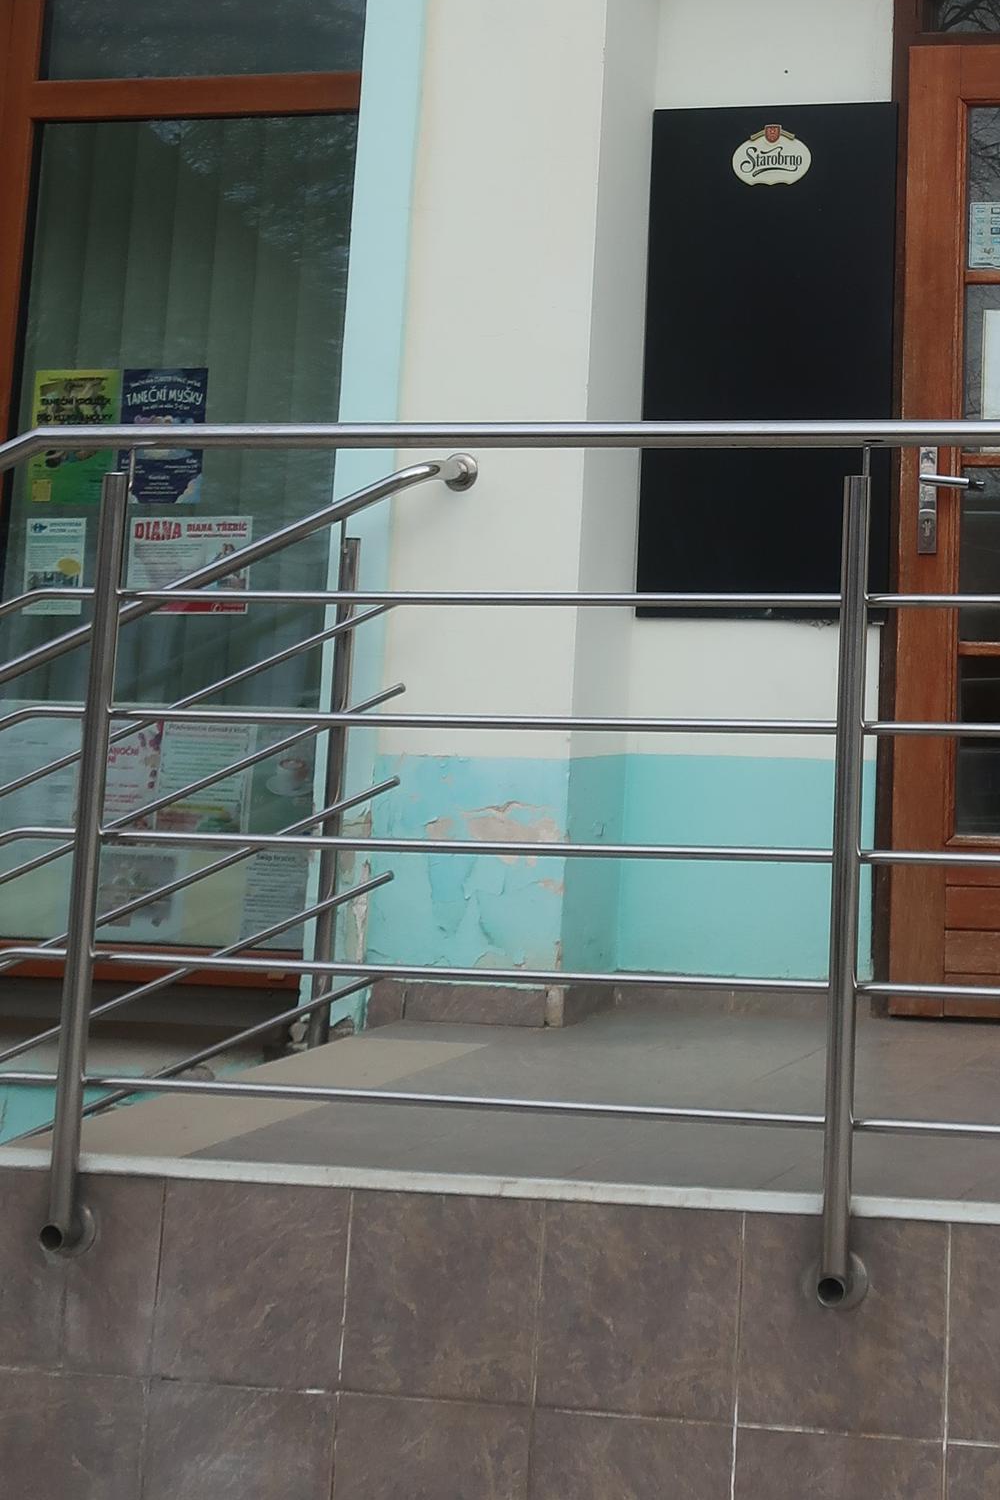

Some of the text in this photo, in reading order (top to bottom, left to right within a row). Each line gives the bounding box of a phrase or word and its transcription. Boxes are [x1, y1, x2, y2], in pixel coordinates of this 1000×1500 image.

[740, 146, 803, 177] Starobrno
[126, 386, 203, 406] TANEČNÍ MYŠKY
[134, 520, 182, 541] DIANA
[186, 523, 213, 532] DIANA
